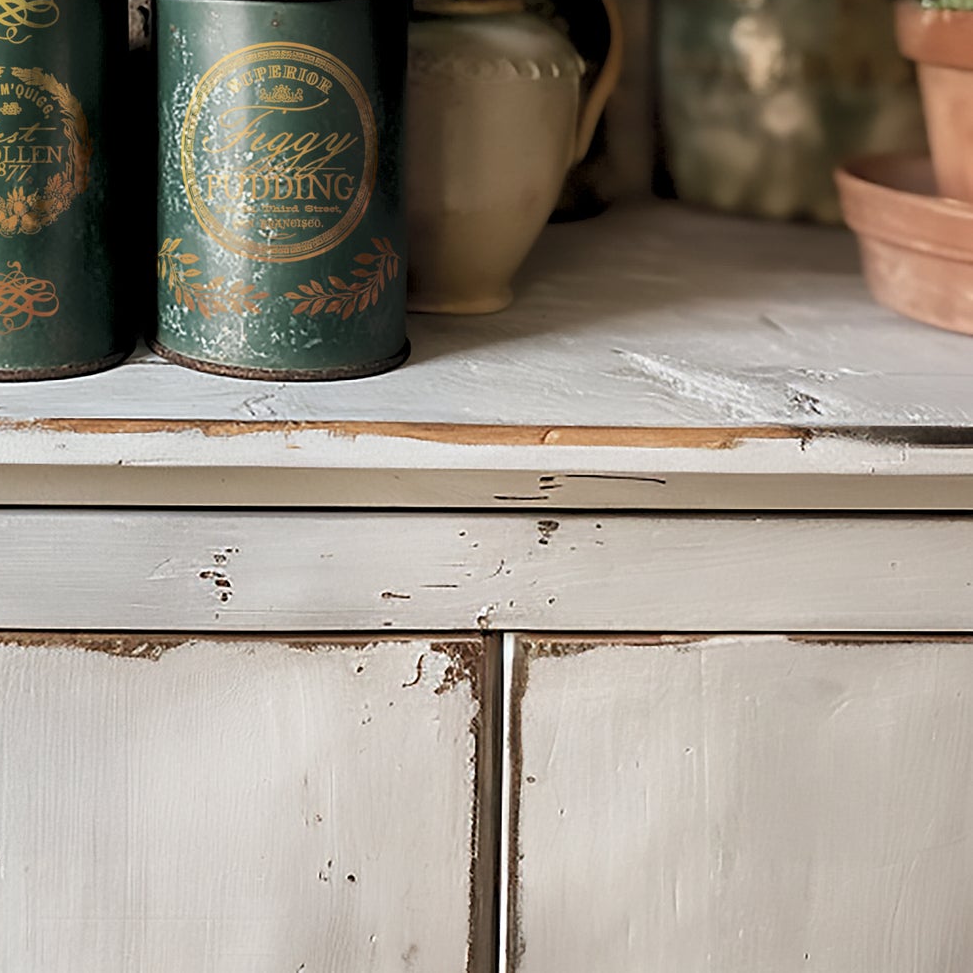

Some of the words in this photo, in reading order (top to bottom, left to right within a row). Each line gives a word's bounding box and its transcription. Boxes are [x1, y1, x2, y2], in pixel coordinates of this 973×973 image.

[227, 64, 333, 96] SUPERIOR
[202, 98, 358, 179] Figgy
[204, 172, 354, 201] PUDDING
